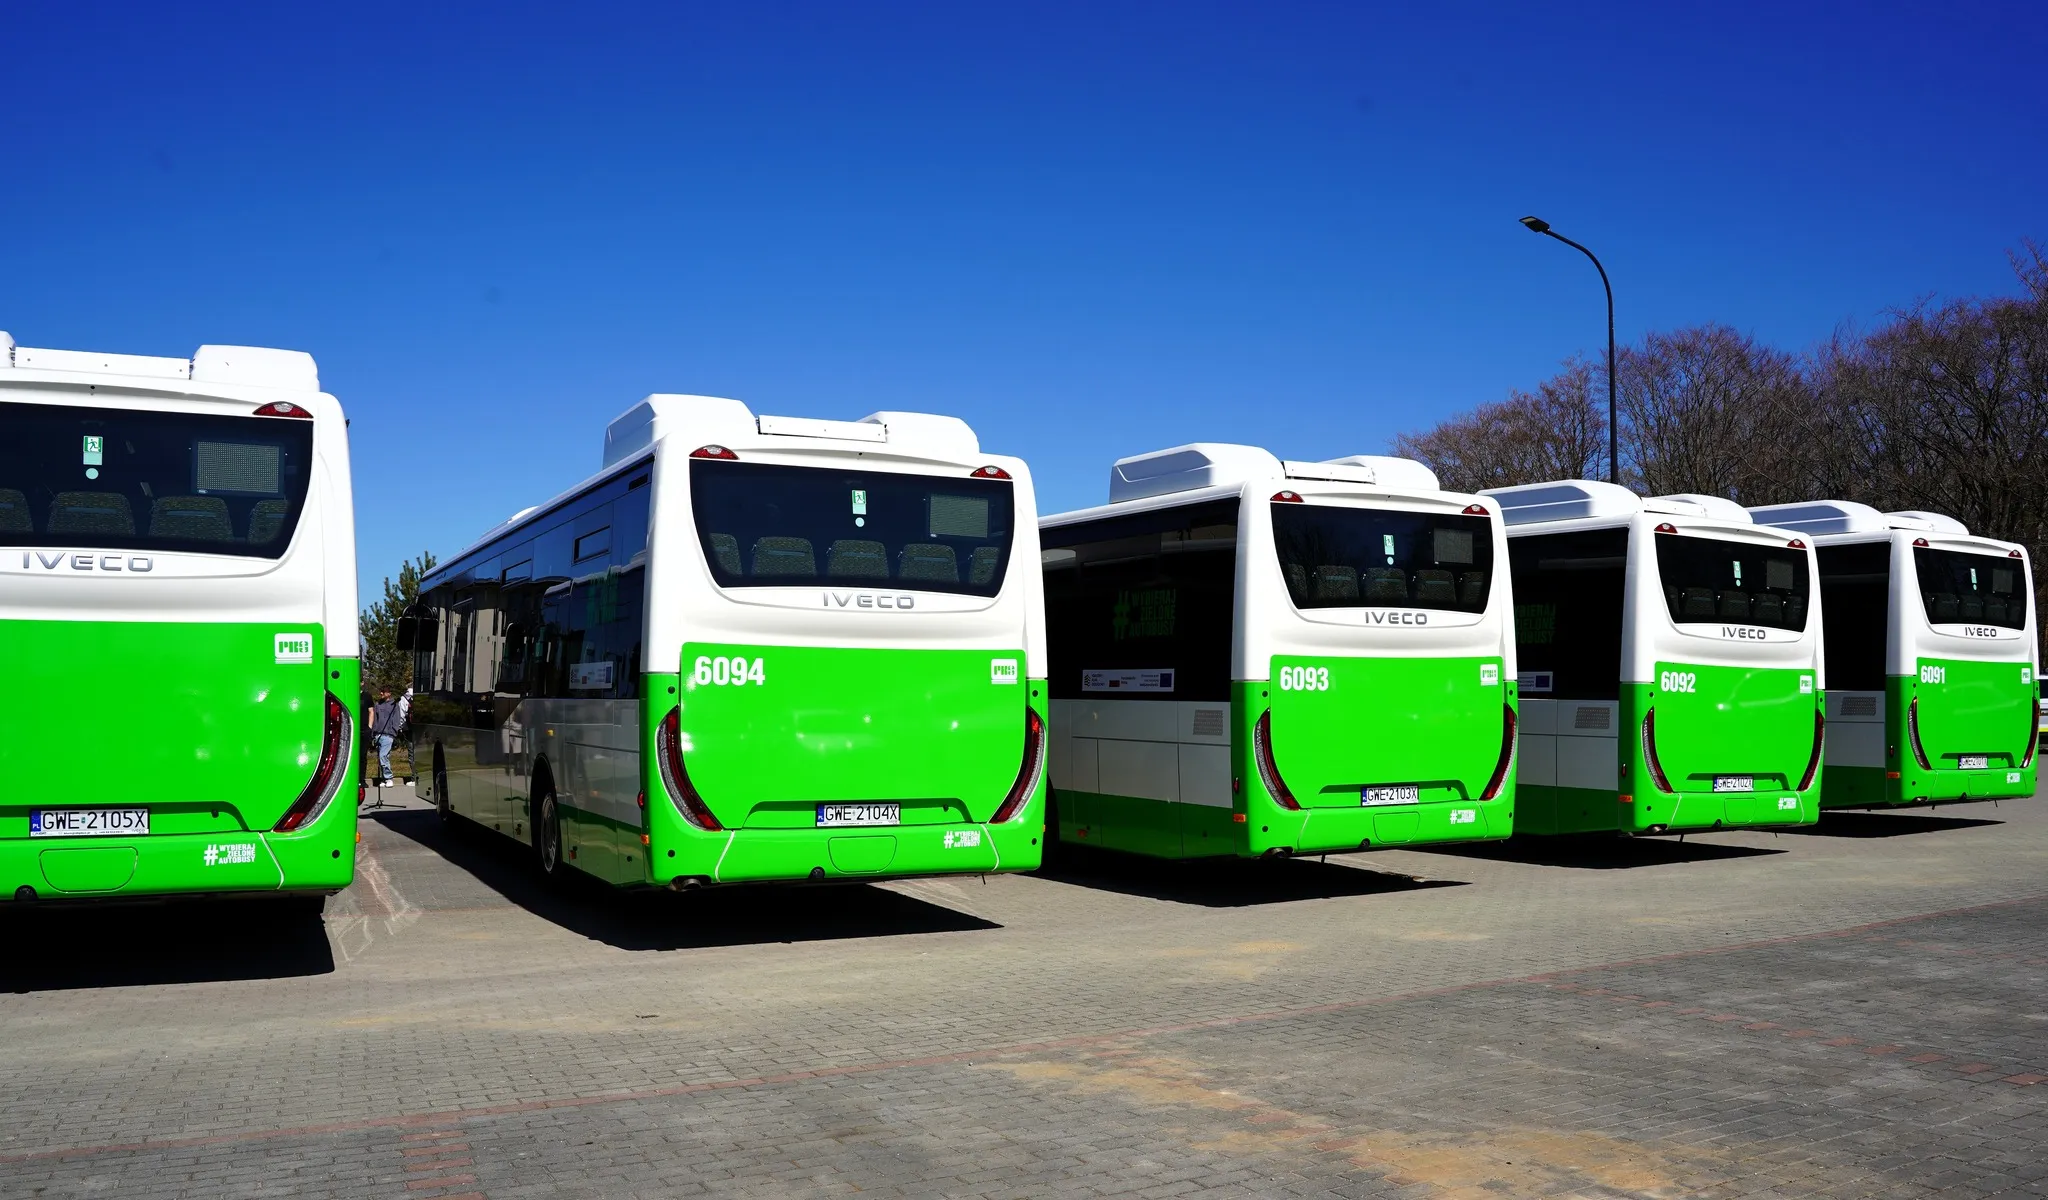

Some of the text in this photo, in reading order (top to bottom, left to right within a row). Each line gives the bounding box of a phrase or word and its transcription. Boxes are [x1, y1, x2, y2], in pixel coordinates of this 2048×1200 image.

[23, 552, 153, 572] IVECO
[823, 592, 915, 609] IVECO
[1365, 612, 1428, 625] IVECO
[1722, 627, 1766, 640] IVECO
[1965, 627, 1997, 637] IVECO
[694, 656, 766, 686] 6094
[1280, 666, 1329, 692] 6093
[1921, 665, 1946, 684] 6091
[1661, 671, 1696, 693] 6092
[1368, 787, 1417, 801] GWE 2103X
[42, 811, 146, 830] GWE 2105X
[825, 805, 898, 821] GWE 2104X
[218, 856, 255, 864] AUTOBUSY
